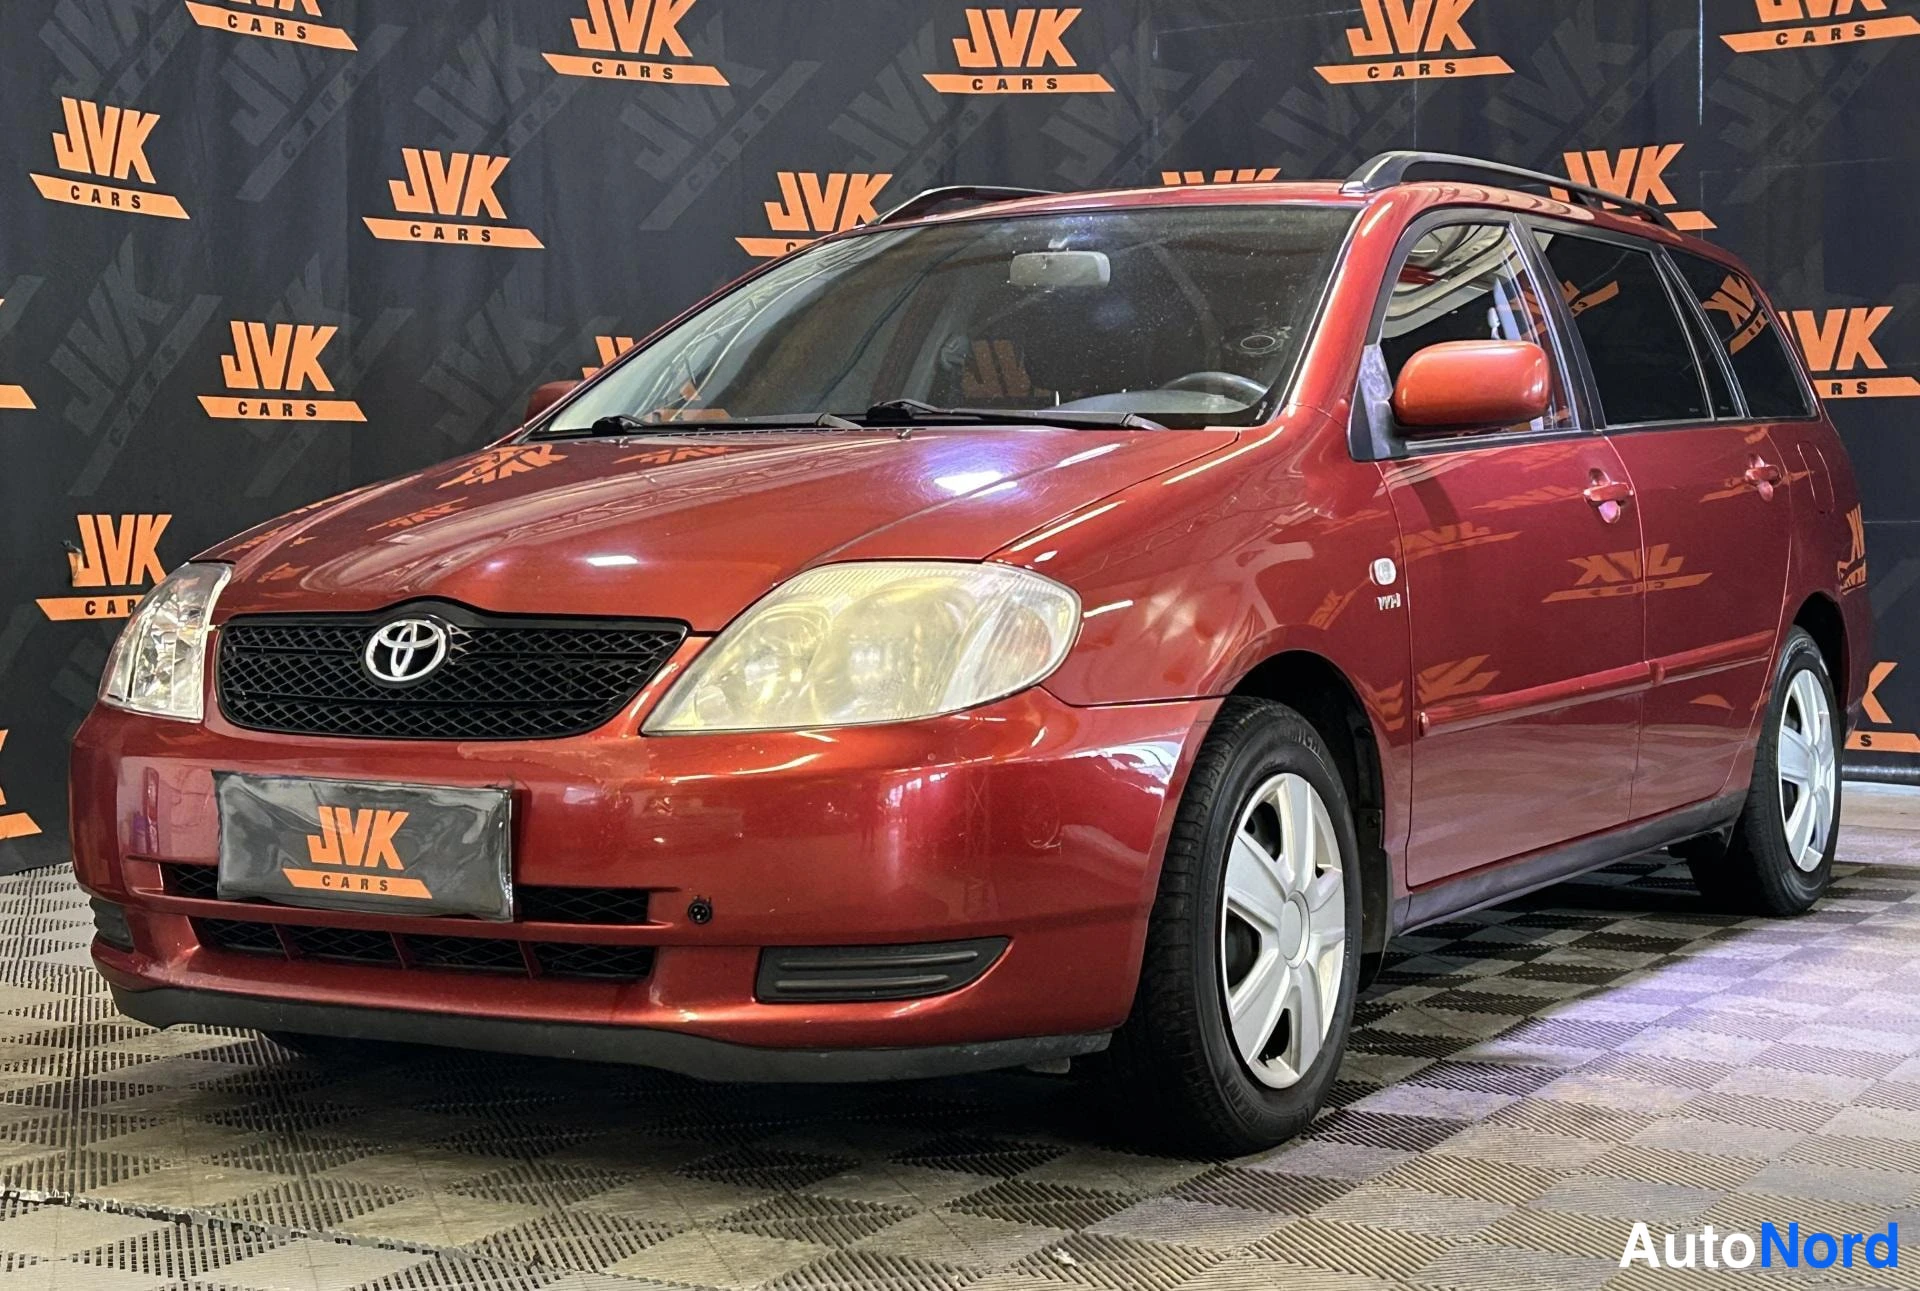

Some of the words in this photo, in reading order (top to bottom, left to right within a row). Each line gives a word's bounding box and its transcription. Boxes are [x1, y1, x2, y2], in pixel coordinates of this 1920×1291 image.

[226, 13, 308, 41] CARS
[570, 0, 694, 57] JVK
[952, 8, 1082, 68] JVK
[1345, 0, 1476, 57] JVK
[1775, 24, 1867, 46] CARS
[591, 61, 674, 80] CARS
[1366, 62, 1457, 79] CARS
[971, 77, 1058, 91] CARS
[52, 97, 160, 184] JVK
[388, 148, 511, 219] JVK
[70, 185, 142, 210] CARS
[764, 171, 894, 233] JVK
[409, 224, 492, 243] CARS
[221, 320, 338, 392] JVK
[1831, 381, 1868, 396] RS
[236, 401, 317, 418] CARS
[69, 514, 172, 587] JVK
[85, 599, 136, 616] CAR
[306, 806, 409, 871] JVK
[321, 874, 389, 892] CARS
